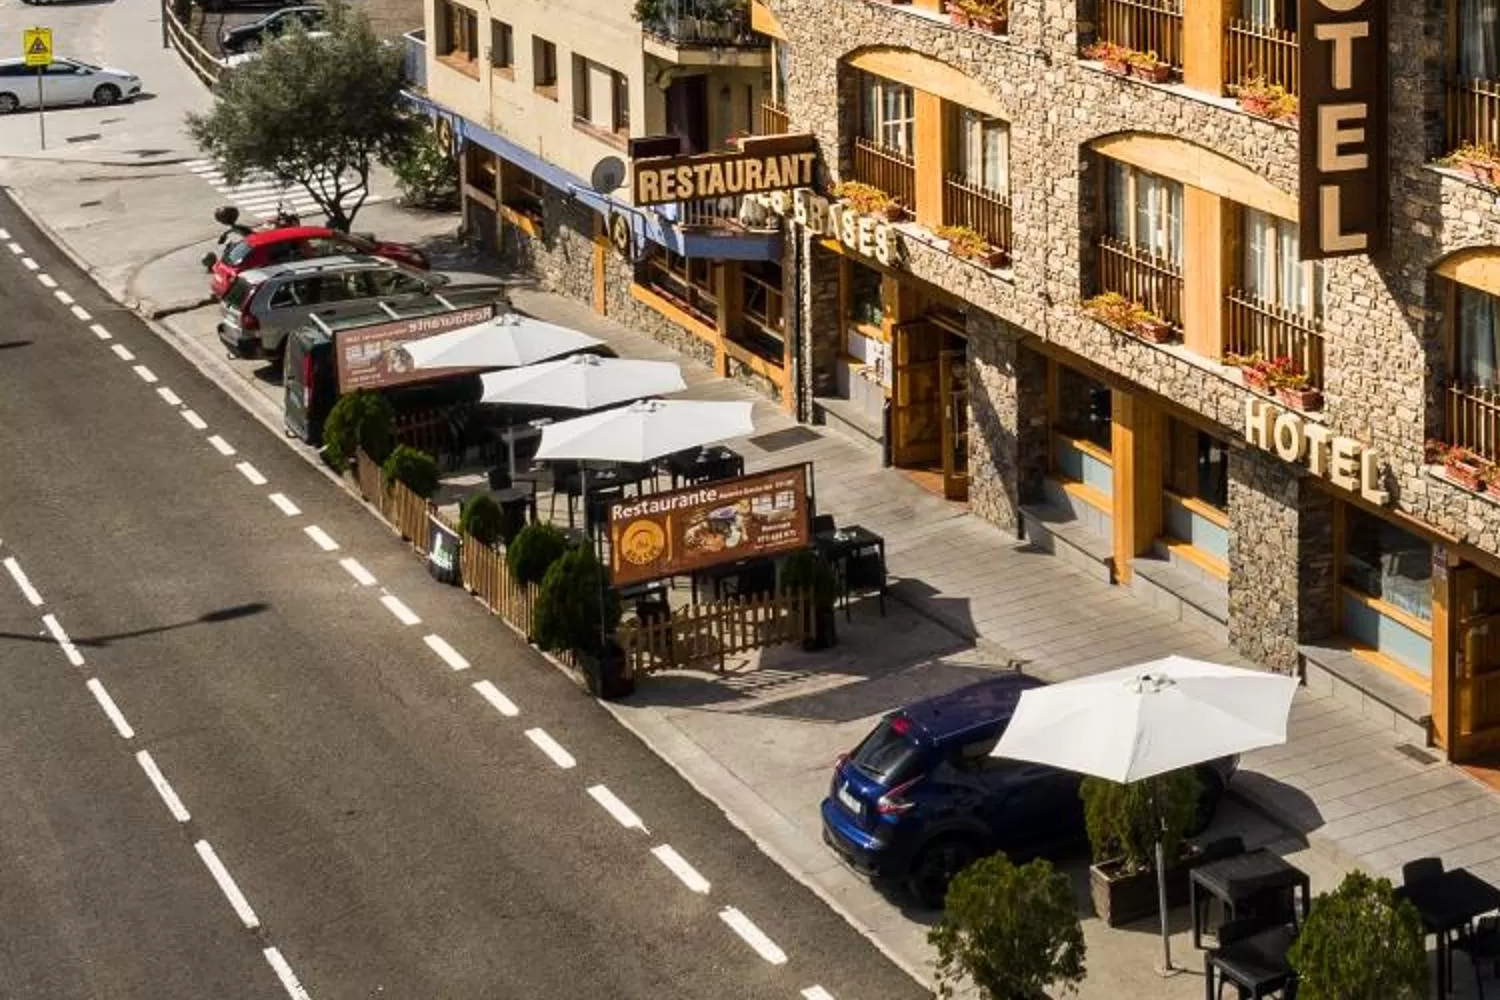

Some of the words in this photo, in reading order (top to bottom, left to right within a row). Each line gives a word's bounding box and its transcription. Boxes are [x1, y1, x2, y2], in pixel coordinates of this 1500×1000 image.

[638, 152, 817, 204] RESTAURANT
[1245, 398, 1390, 506] HOTEL
[611, 487, 719, 521] Restaurante
